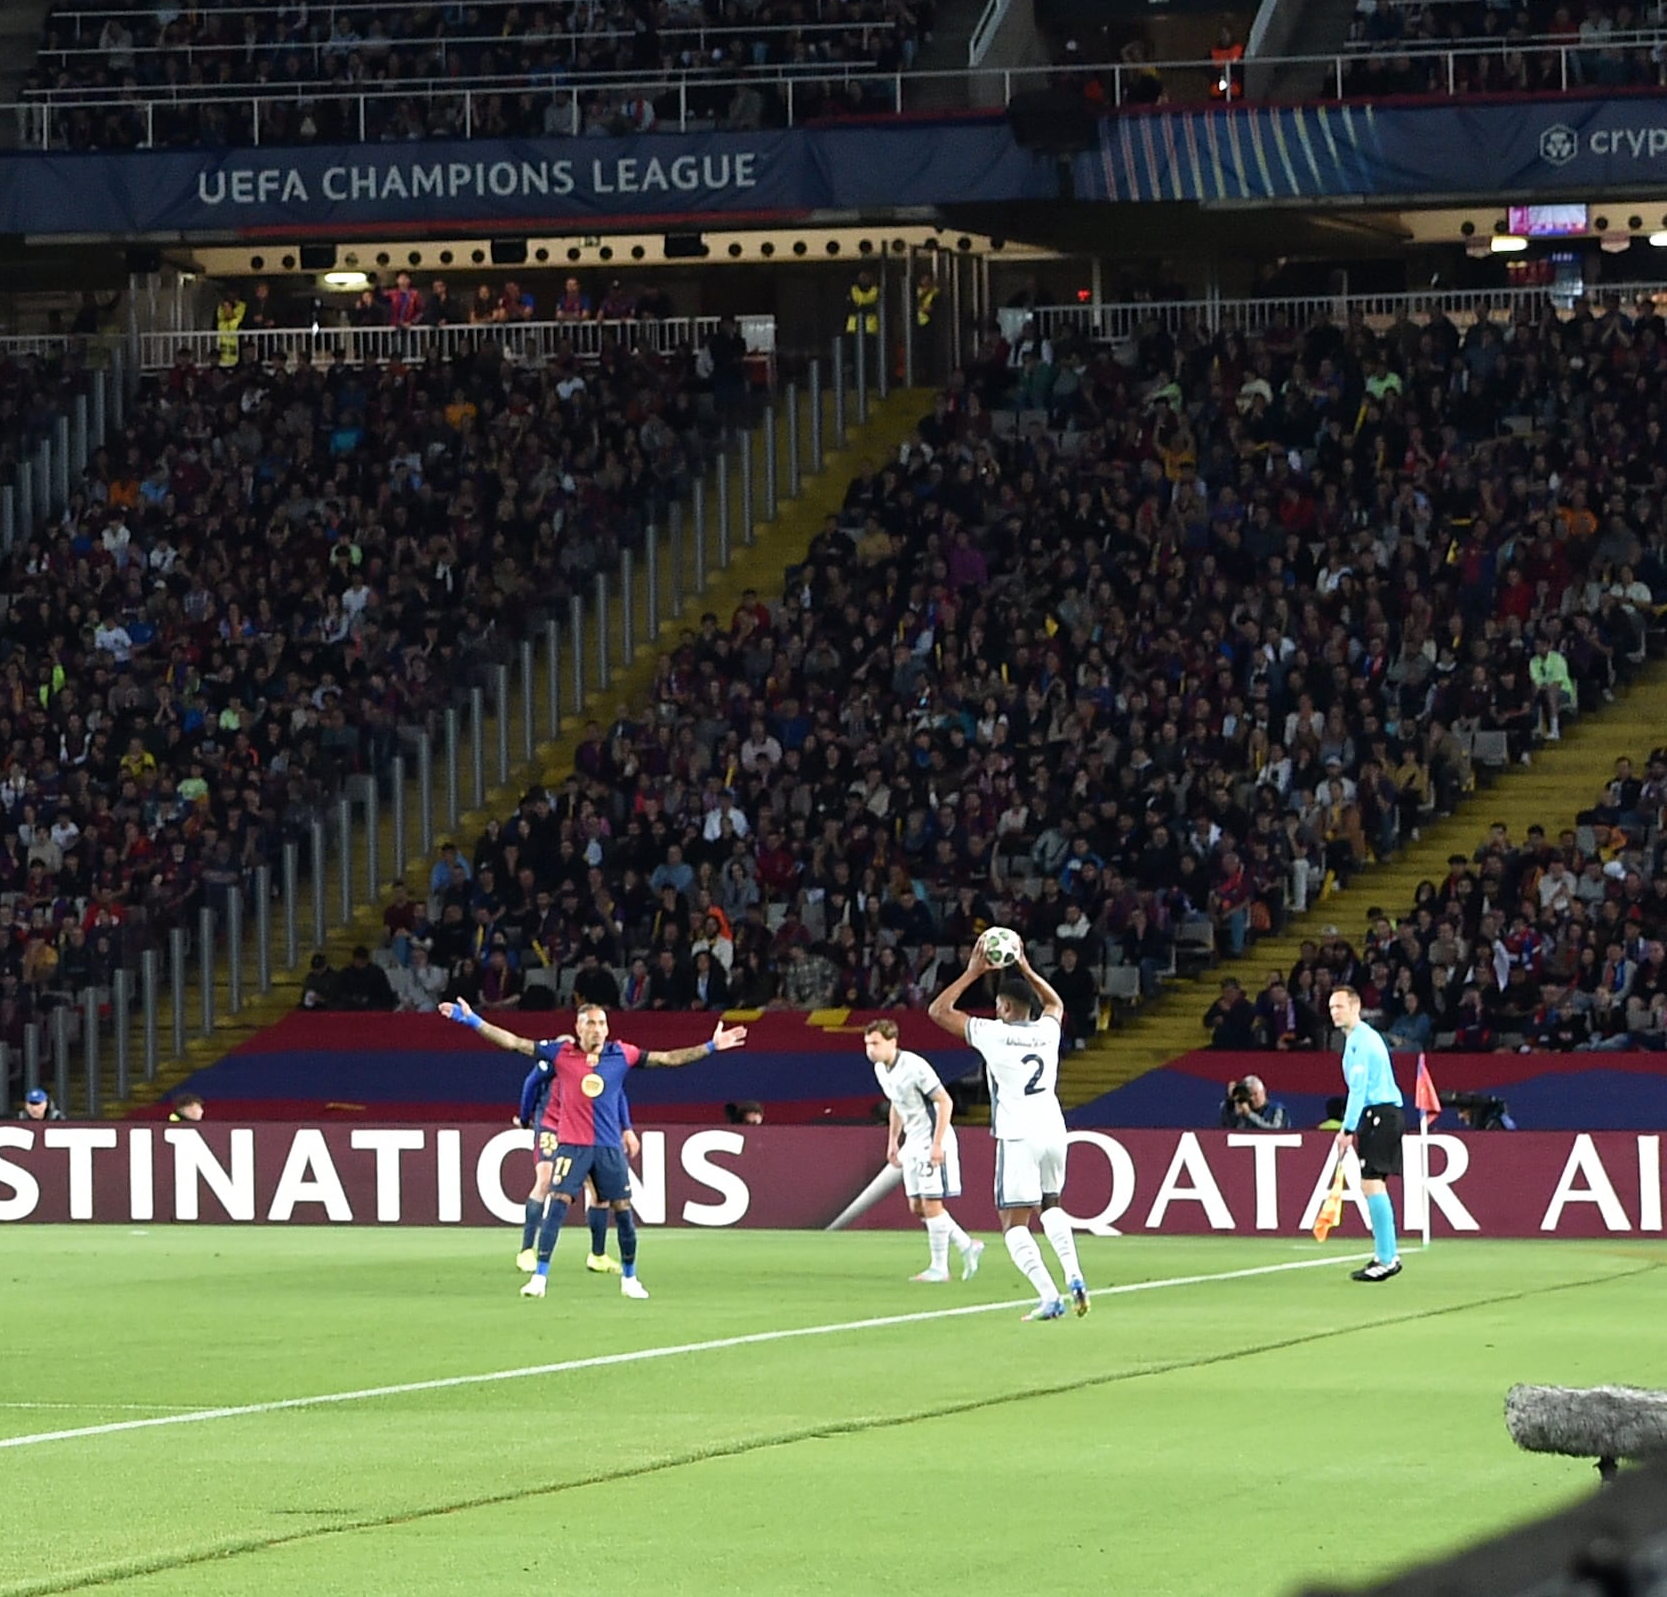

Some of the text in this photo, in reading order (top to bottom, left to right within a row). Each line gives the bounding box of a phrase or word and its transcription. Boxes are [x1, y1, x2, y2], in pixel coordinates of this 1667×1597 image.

[198, 152, 757, 204] UEFA CHAMPIONS LEAGUE
[1020, 1053, 1046, 1096] 2
[554, 1156, 572, 1177] 11
